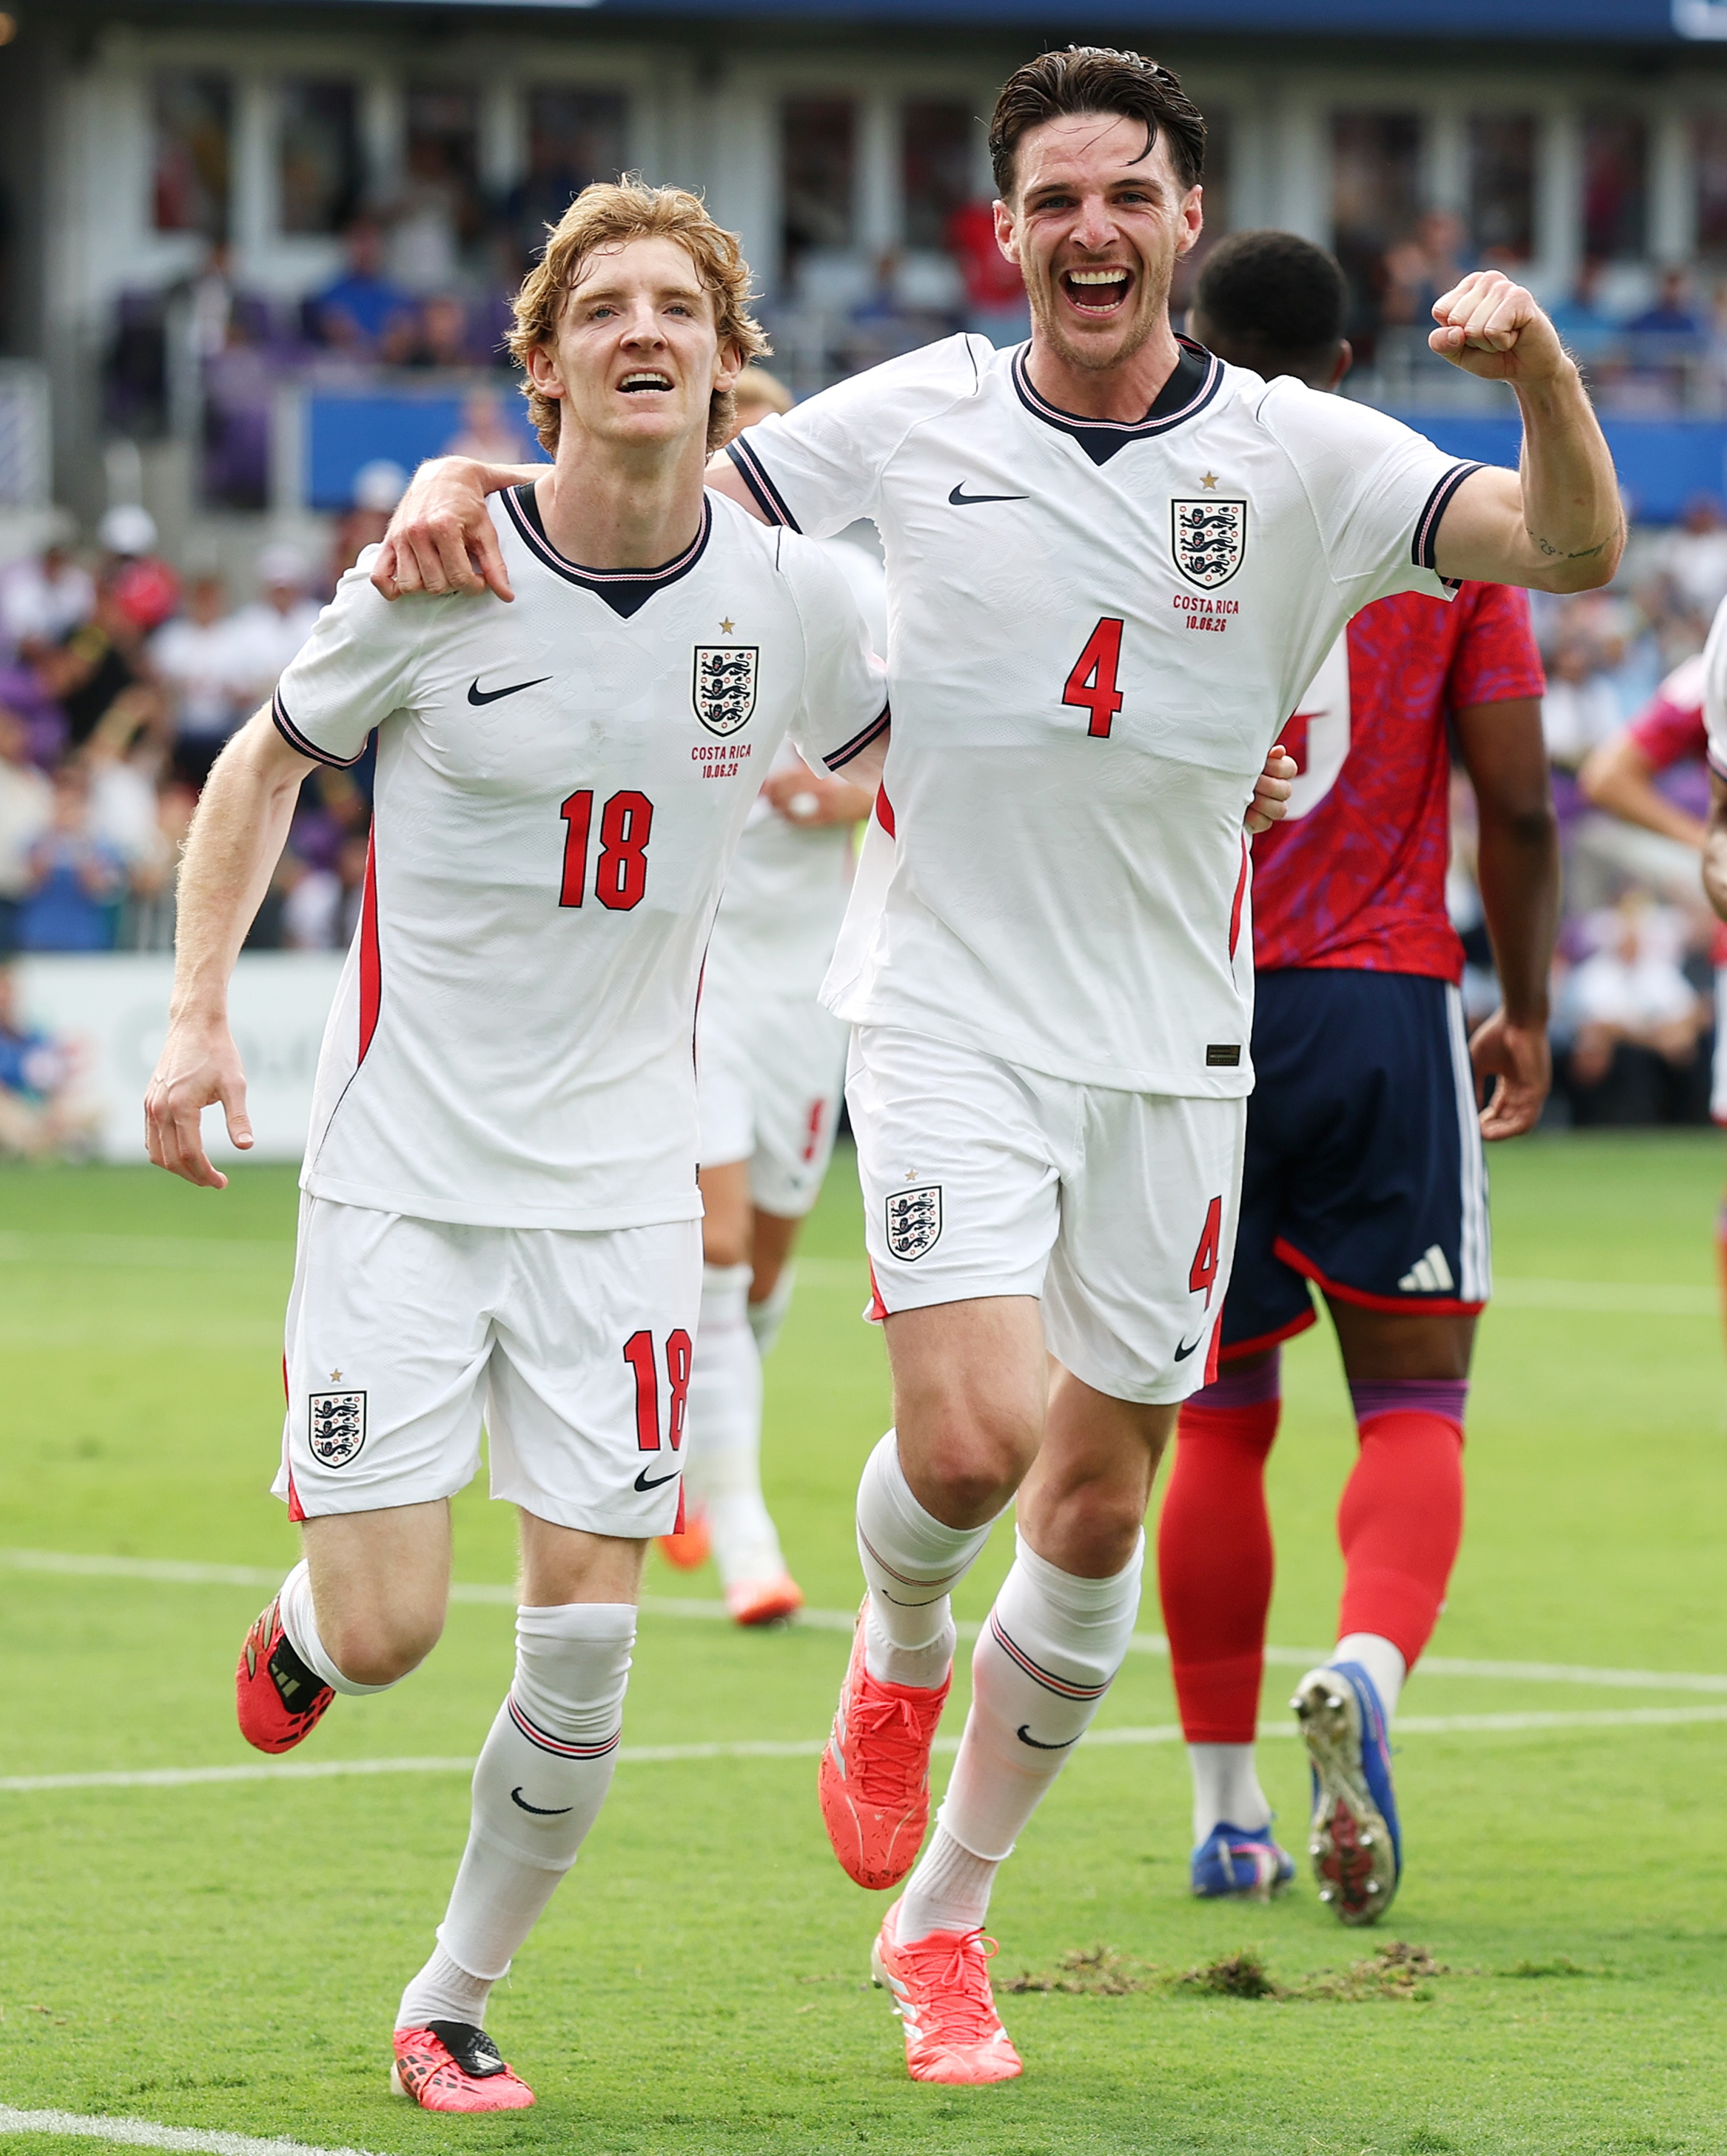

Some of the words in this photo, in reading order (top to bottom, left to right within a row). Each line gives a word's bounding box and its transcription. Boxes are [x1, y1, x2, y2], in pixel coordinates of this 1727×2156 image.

[1173, 595, 1213, 613] COSTA
[1216, 600, 1239, 614] RICA
[1186, 615, 1227, 632] 10.06.26
[1061, 617, 1124, 739] 4
[691, 746, 726, 761] COSTA
[729, 744, 751, 759] RICA
[702, 763, 739, 778] 10.06.26
[559, 790, 654, 911] 18
[1189, 1194, 1222, 1312] 4
[623, 1328, 692, 1451] 18
